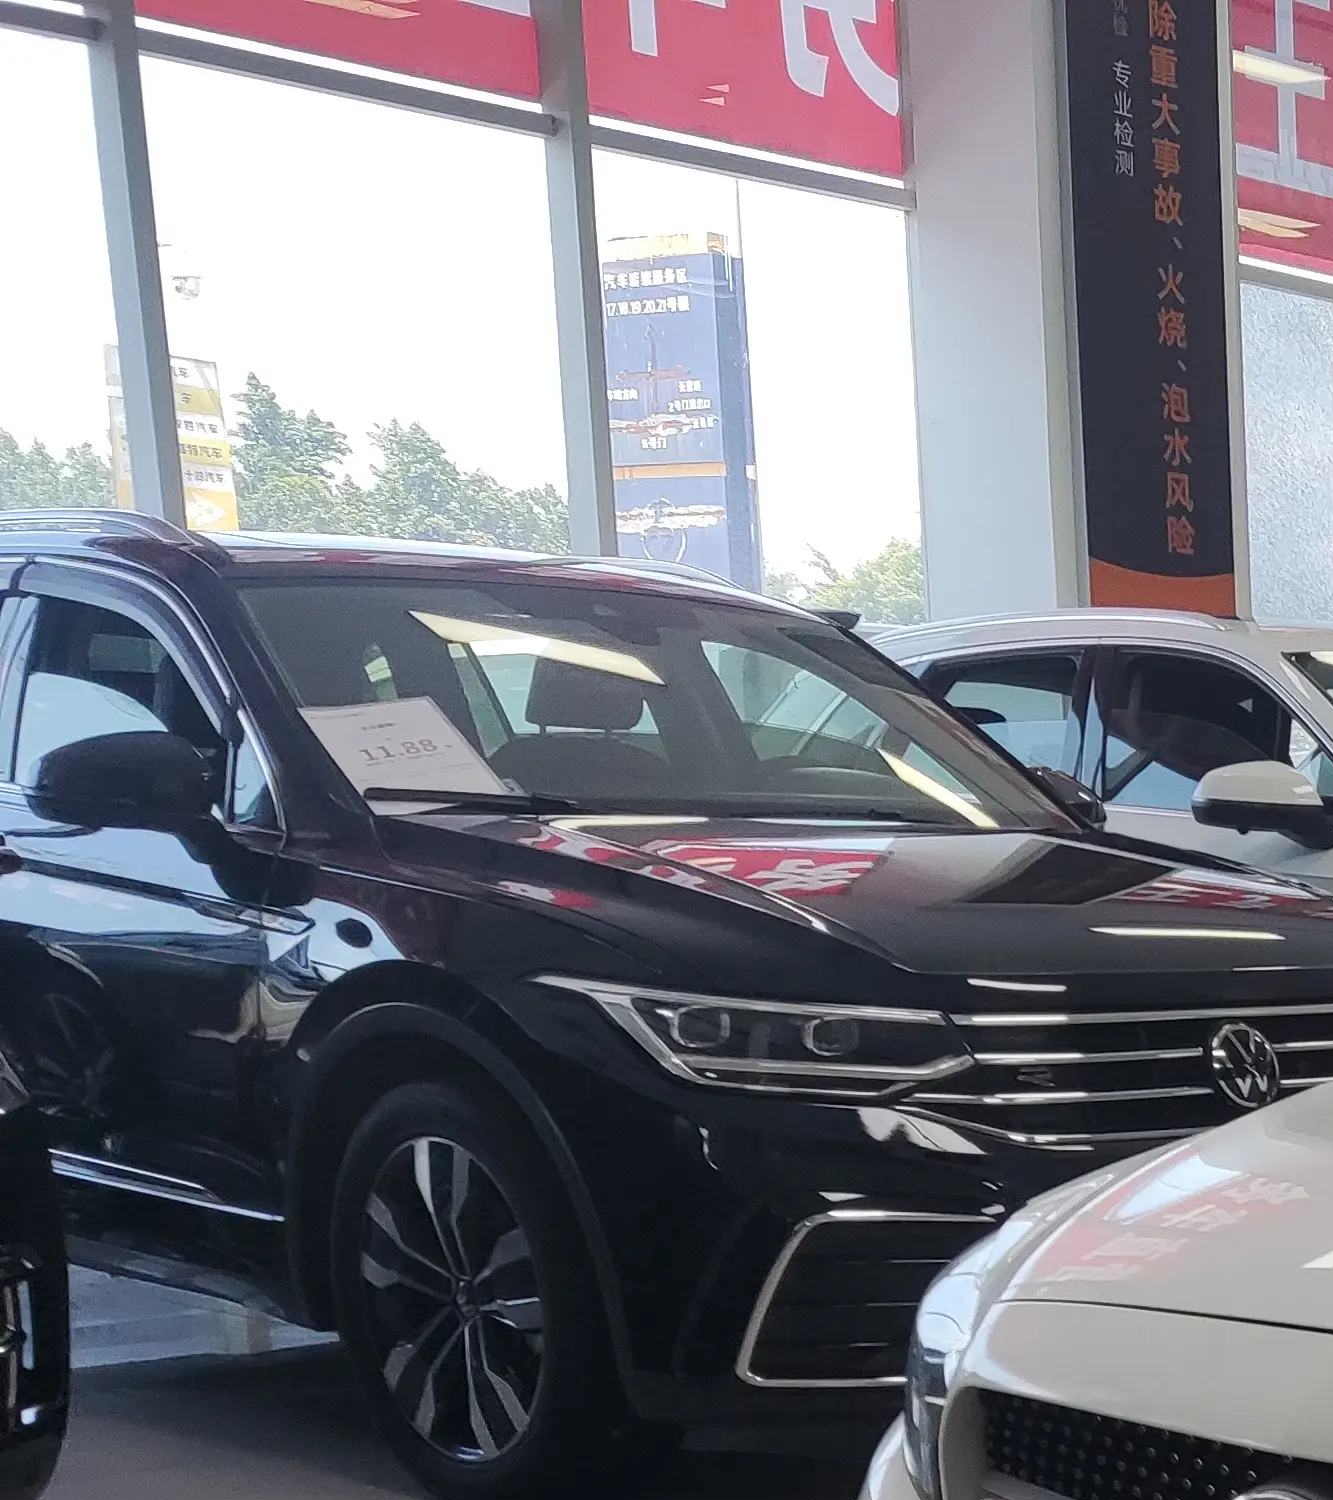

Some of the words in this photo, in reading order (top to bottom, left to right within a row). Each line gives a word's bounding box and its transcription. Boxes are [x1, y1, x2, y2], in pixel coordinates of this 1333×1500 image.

[1112, 60, 1135, 178] 专业检测
[359, 737, 440, 764] 11.88
